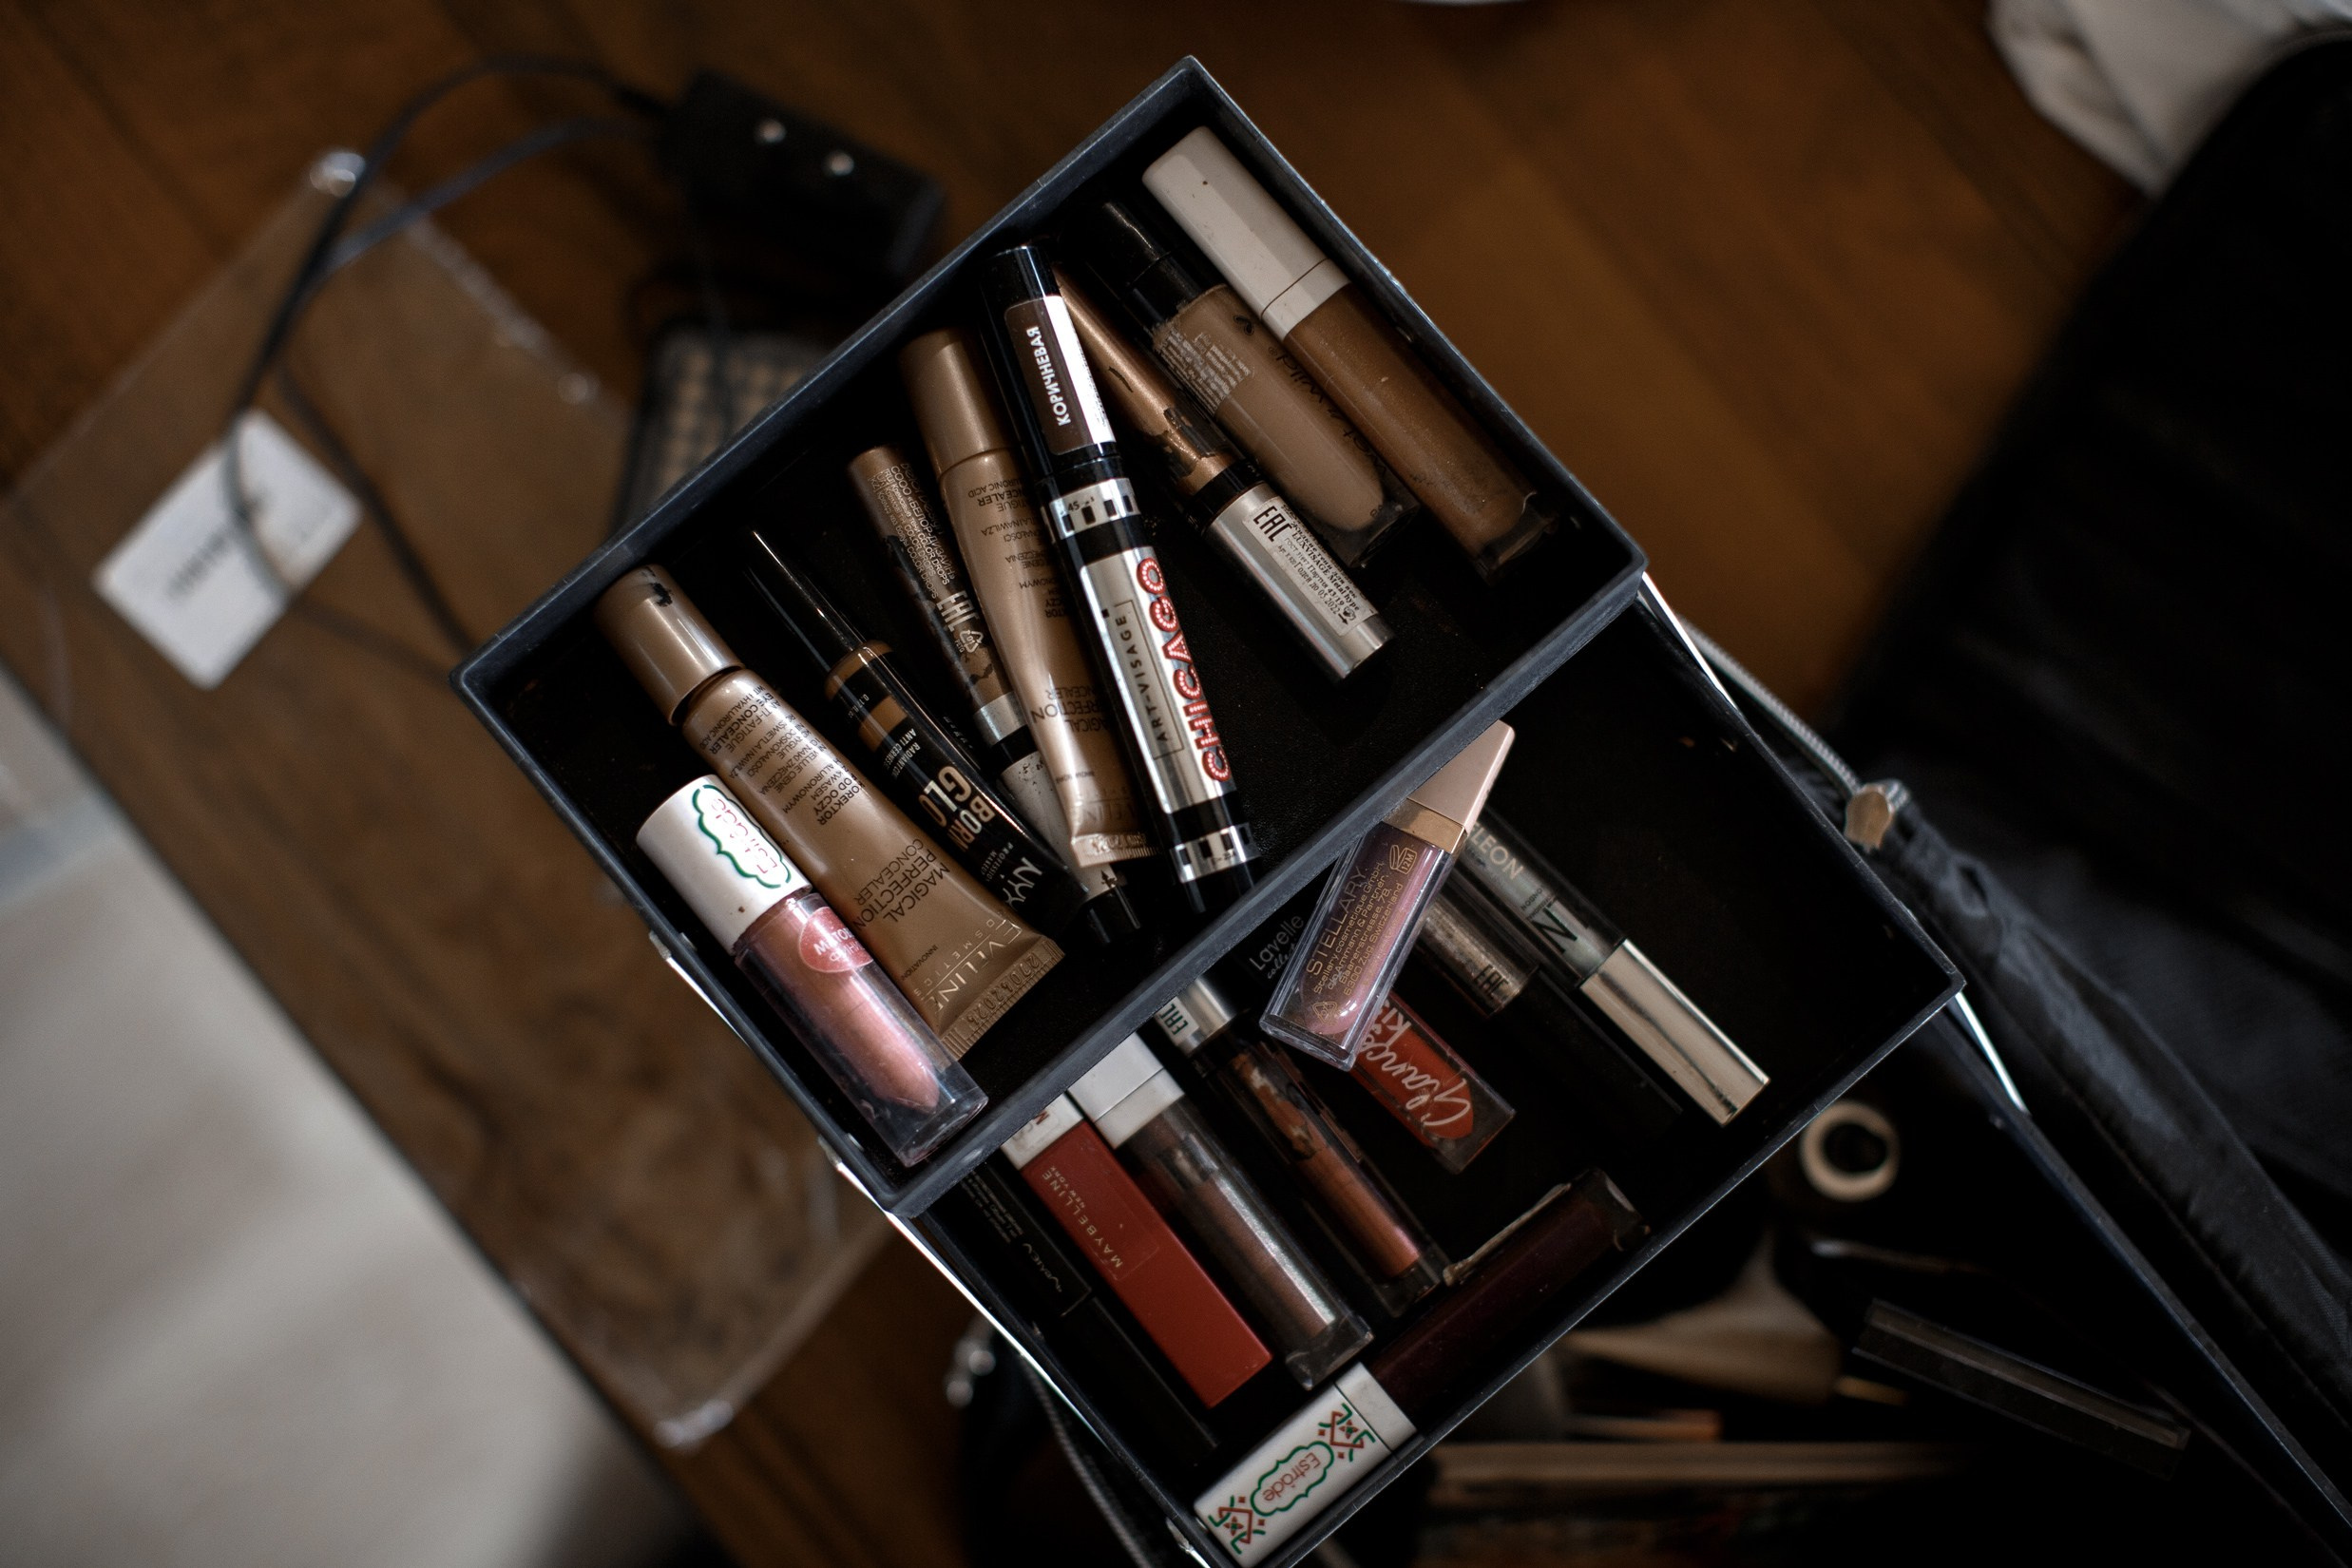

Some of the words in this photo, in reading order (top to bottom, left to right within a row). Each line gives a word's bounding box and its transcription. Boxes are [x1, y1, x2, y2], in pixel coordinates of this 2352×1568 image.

[1025, 325, 1072, 426] КОРИЧНЕВАЯ
[889, 465, 911, 496] СООО
[966, 485, 987, 498] ACID
[903, 524, 923, 551] COLOR
[918, 550, 936, 577] DROPS
[906, 545, 926, 574] COLOR
[920, 572, 939, 599] DROPS
[916, 532, 936, 559] COLOR
[931, 559, 950, 585] DROPS
[1291, 531, 1329, 575] LUXVISAGE
[1327, 573, 1347, 594] Metal
[1343, 592, 1361, 613] hype
[1293, 561, 1313, 583] Годен
[1309, 581, 1320, 592] до
[1316, 588, 1340, 615] 05.2022
[1307, 564, 1329, 588] Партия
[1326, 586, 1345, 606] 43/19
[1114, 614, 1169, 743] ART-VISAGE
[1131, 554, 1233, 786] CHICAGO
[708, 695, 751, 737] HYALURONIC
[708, 703, 759, 755] CONCEALER
[898, 727, 918, 746] ANTI
[727, 750, 755, 779] NAWILŻA
[757, 757, 795, 796] ZMĘCZENIA
[773, 770, 797, 793] CIENIE
[894, 741, 921, 770] RADIANT
[781, 756, 840, 813] HALURONOWYM
[810, 769, 843, 800] KWASEM
[811, 788, 839, 815] OCZY
[816, 780, 865, 826] KOREKTOR
[942, 794, 999, 852] BORN
[852, 836, 926, 907] CONCEALER
[996, 855, 1043, 912] NYX
[1400, 852, 1415, 871] 12M
[851, 848, 937, 932] PERFECTION
[882, 860, 950, 927] MAGICAL
[1246, 911, 1307, 971] Lavelle
[1304, 865, 1368, 977] STELLARY
[1312, 952, 1340, 994] Stellary
[1332, 892, 1368, 953] cosmetique
[1333, 927, 1361, 973] Ammann
[1361, 871, 1388, 918] Partner,
[1338, 903, 1384, 985] Baarerstrasse,
[1342, 965, 1363, 996] 6300
[1358, 942, 1375, 966] Zug,
[1368, 881, 1404, 944] Switzerland
[924, 915, 1023, 1015] EVELINE
[1049, 1165, 1069, 1188] YORK
[1068, 1188, 1086, 1208] NEW
[1041, 1169, 1123, 1268] MAYBELLINE
